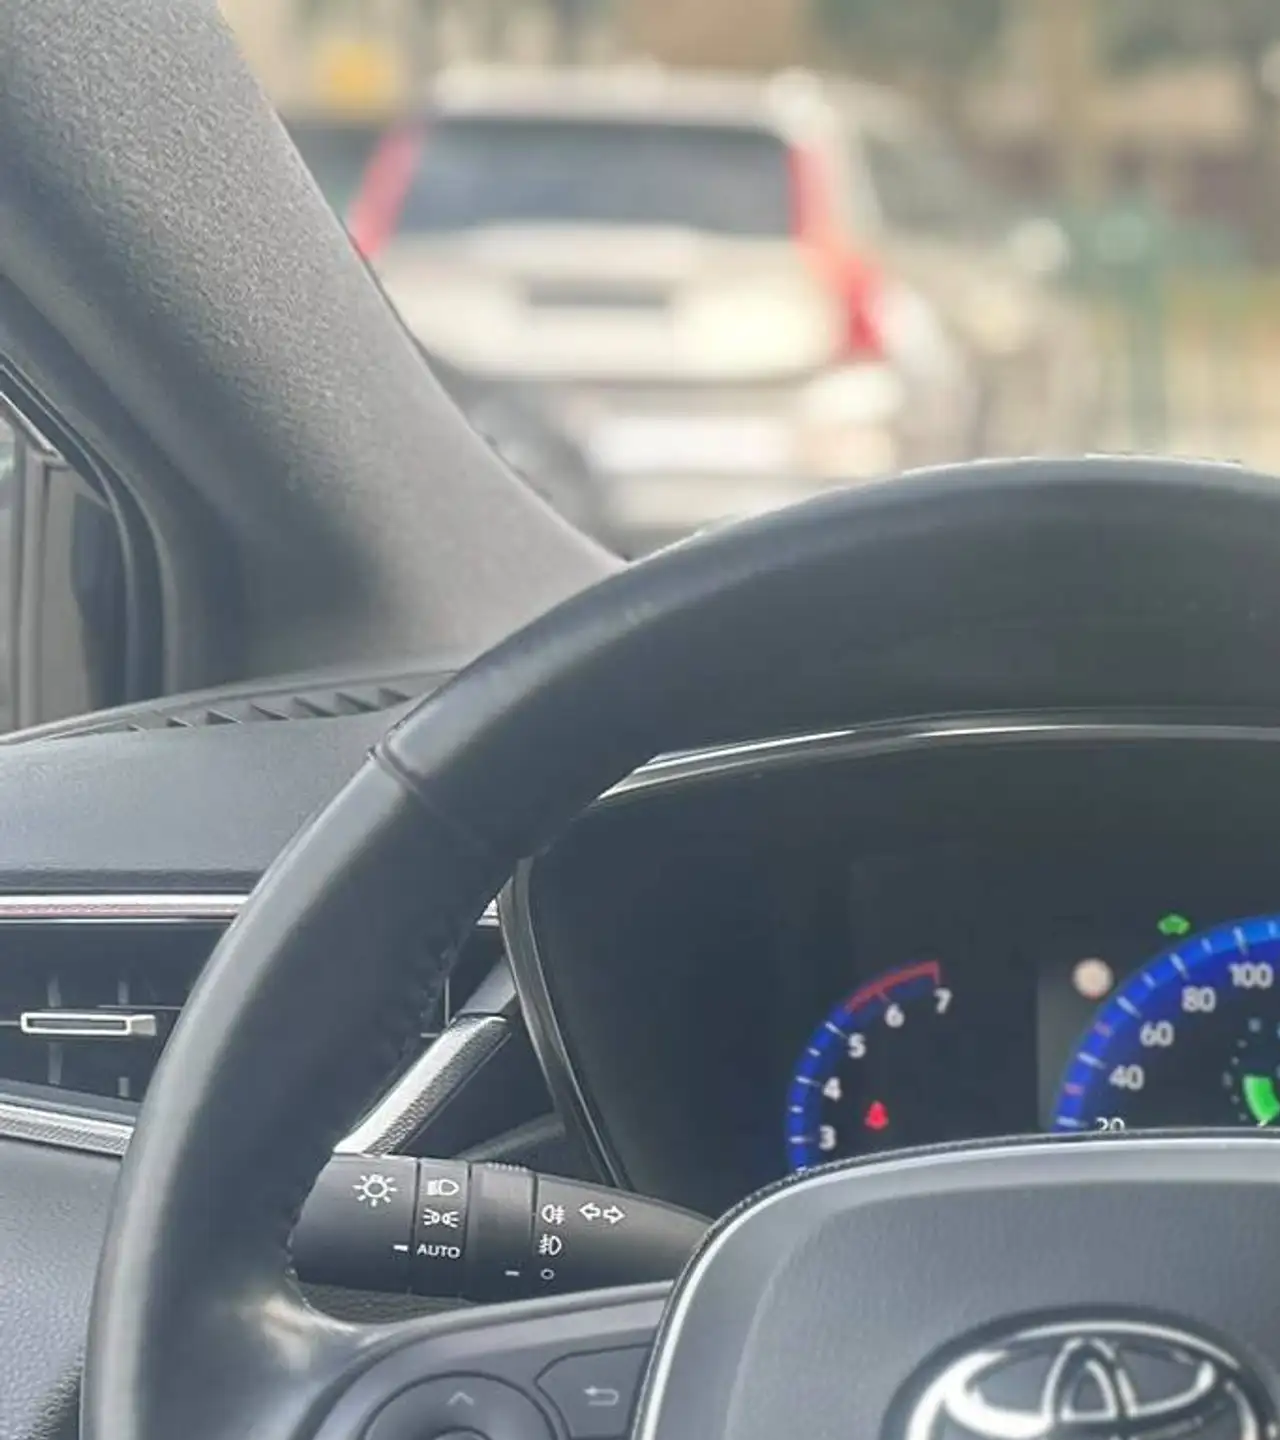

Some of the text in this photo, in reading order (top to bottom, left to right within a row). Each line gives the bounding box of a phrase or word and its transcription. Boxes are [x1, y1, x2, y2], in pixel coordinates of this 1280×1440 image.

[1228, 963, 1274, 989] 100
[934, 986, 953, 1014] 7
[1180, 985, 1217, 1013] 80
[884, 1002, 906, 1029] 6
[847, 1031, 867, 1059] 5
[1138, 1020, 1176, 1047] 60
[822, 1075, 843, 1103] 4
[1108, 1064, 1145, 1091] 40
[818, 1123, 838, 1151] 3
[416, 1242, 461, 1260] AUTO
